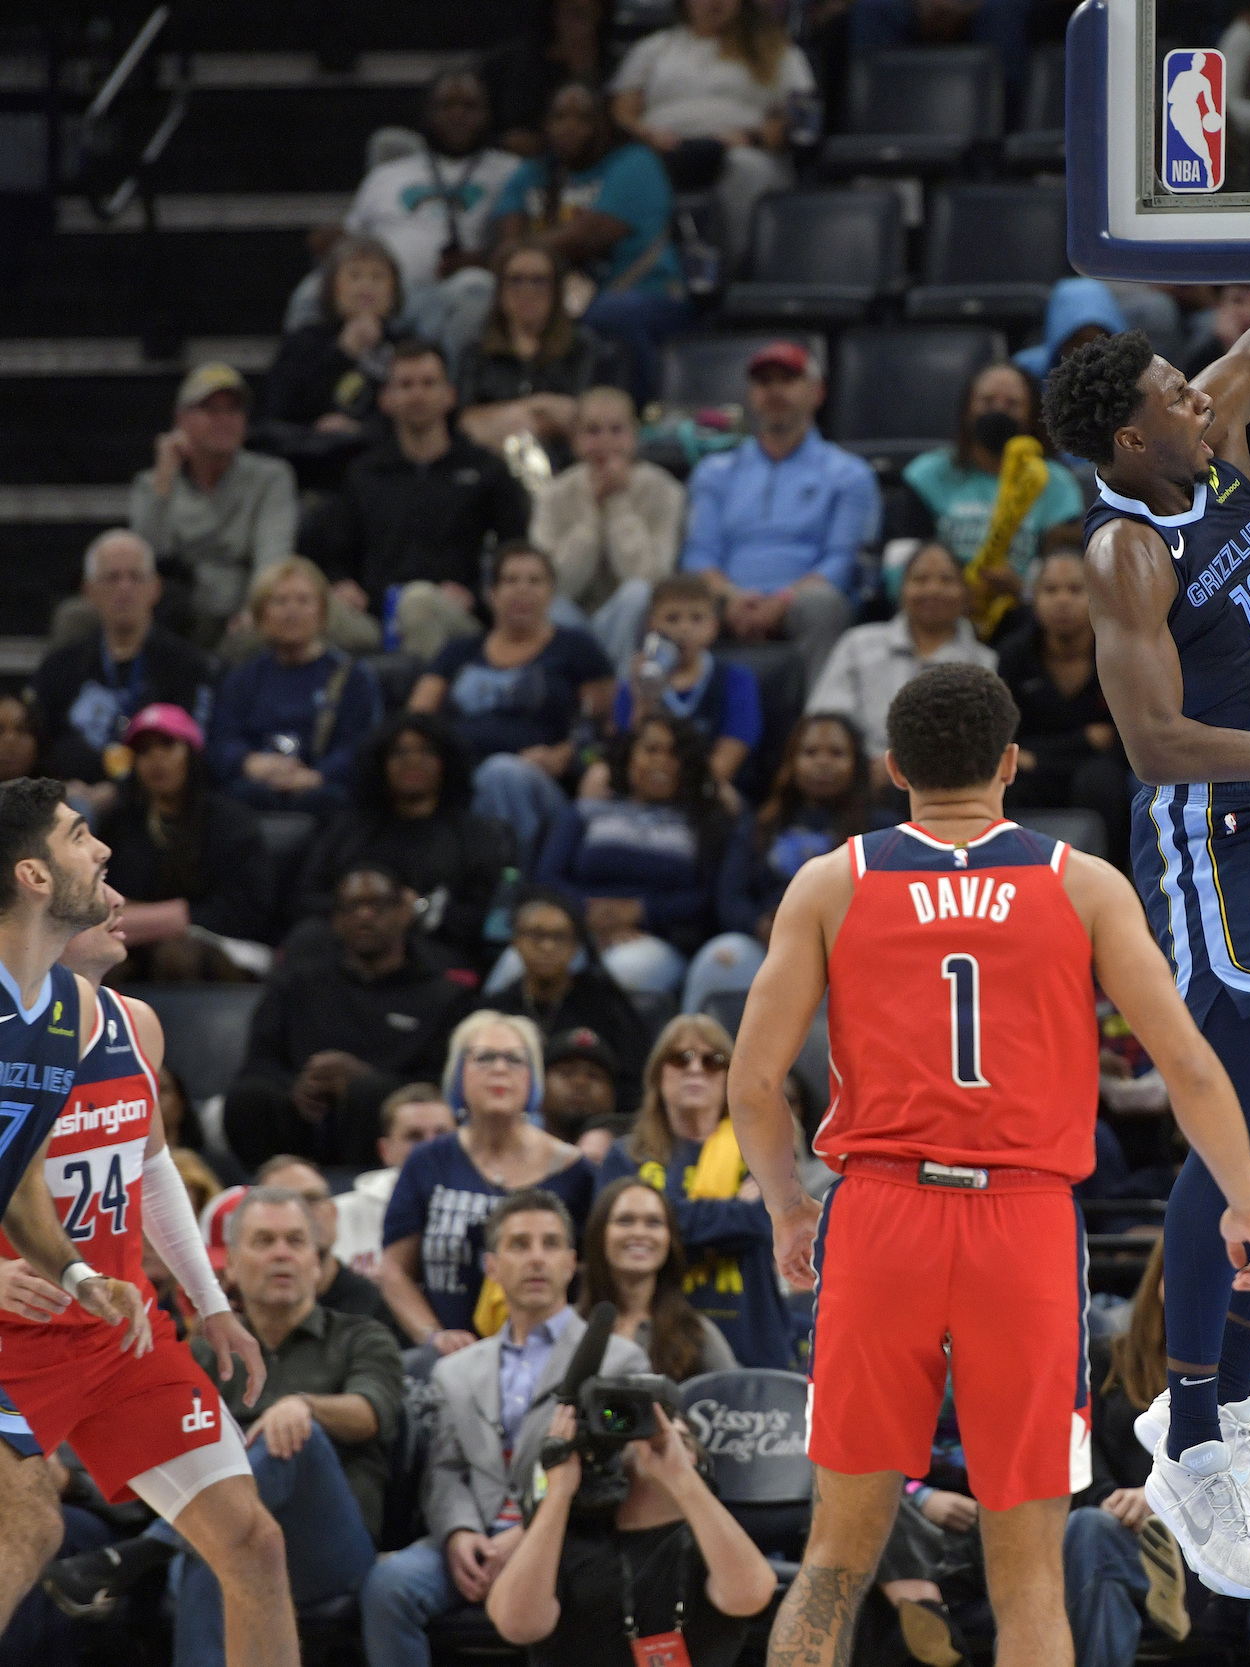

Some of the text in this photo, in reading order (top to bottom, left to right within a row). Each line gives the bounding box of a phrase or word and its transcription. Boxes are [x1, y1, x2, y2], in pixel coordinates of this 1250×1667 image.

[1172, 160, 1201, 182] NBA
[908, 876, 1016, 924] DAVIS
[941, 953, 992, 1088] 1
[52, 1098, 147, 1138] ashington
[62, 1152, 129, 1242] 24
